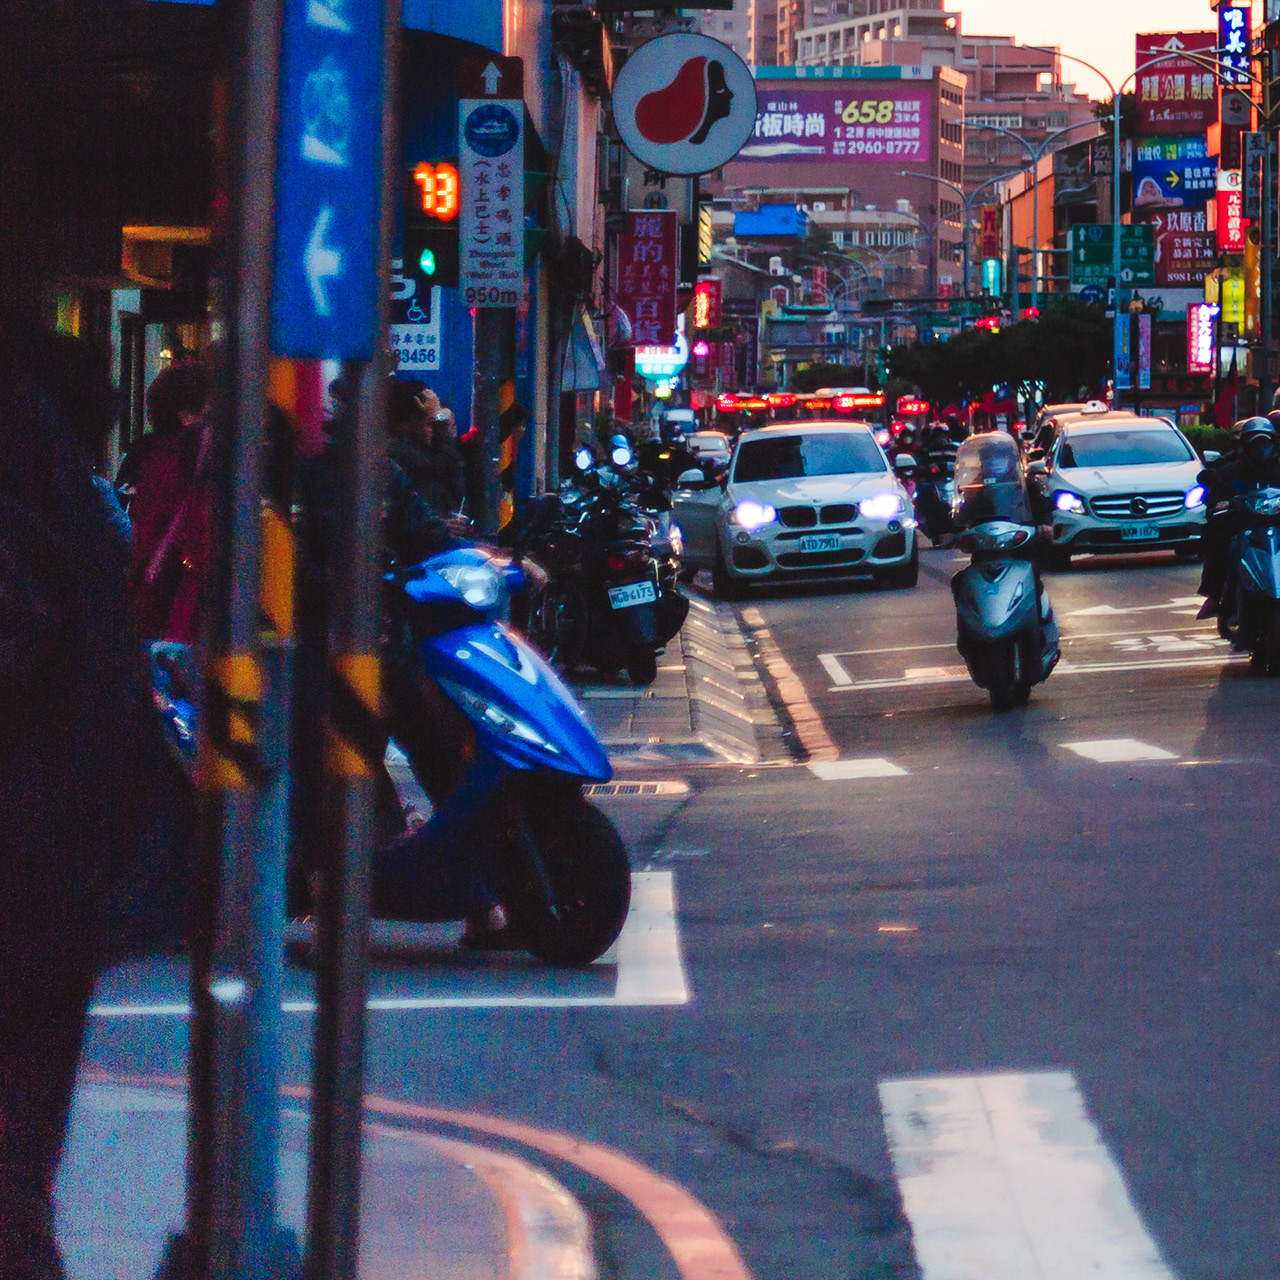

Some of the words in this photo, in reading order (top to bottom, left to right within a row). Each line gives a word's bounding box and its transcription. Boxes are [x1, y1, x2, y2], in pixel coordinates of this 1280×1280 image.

[842, 100, 895, 124] 658
[848, 140, 921, 155] 2960-8777
[495, 162, 512, 247] 忠孝碼頭
[465, 287, 517, 304] 950m
